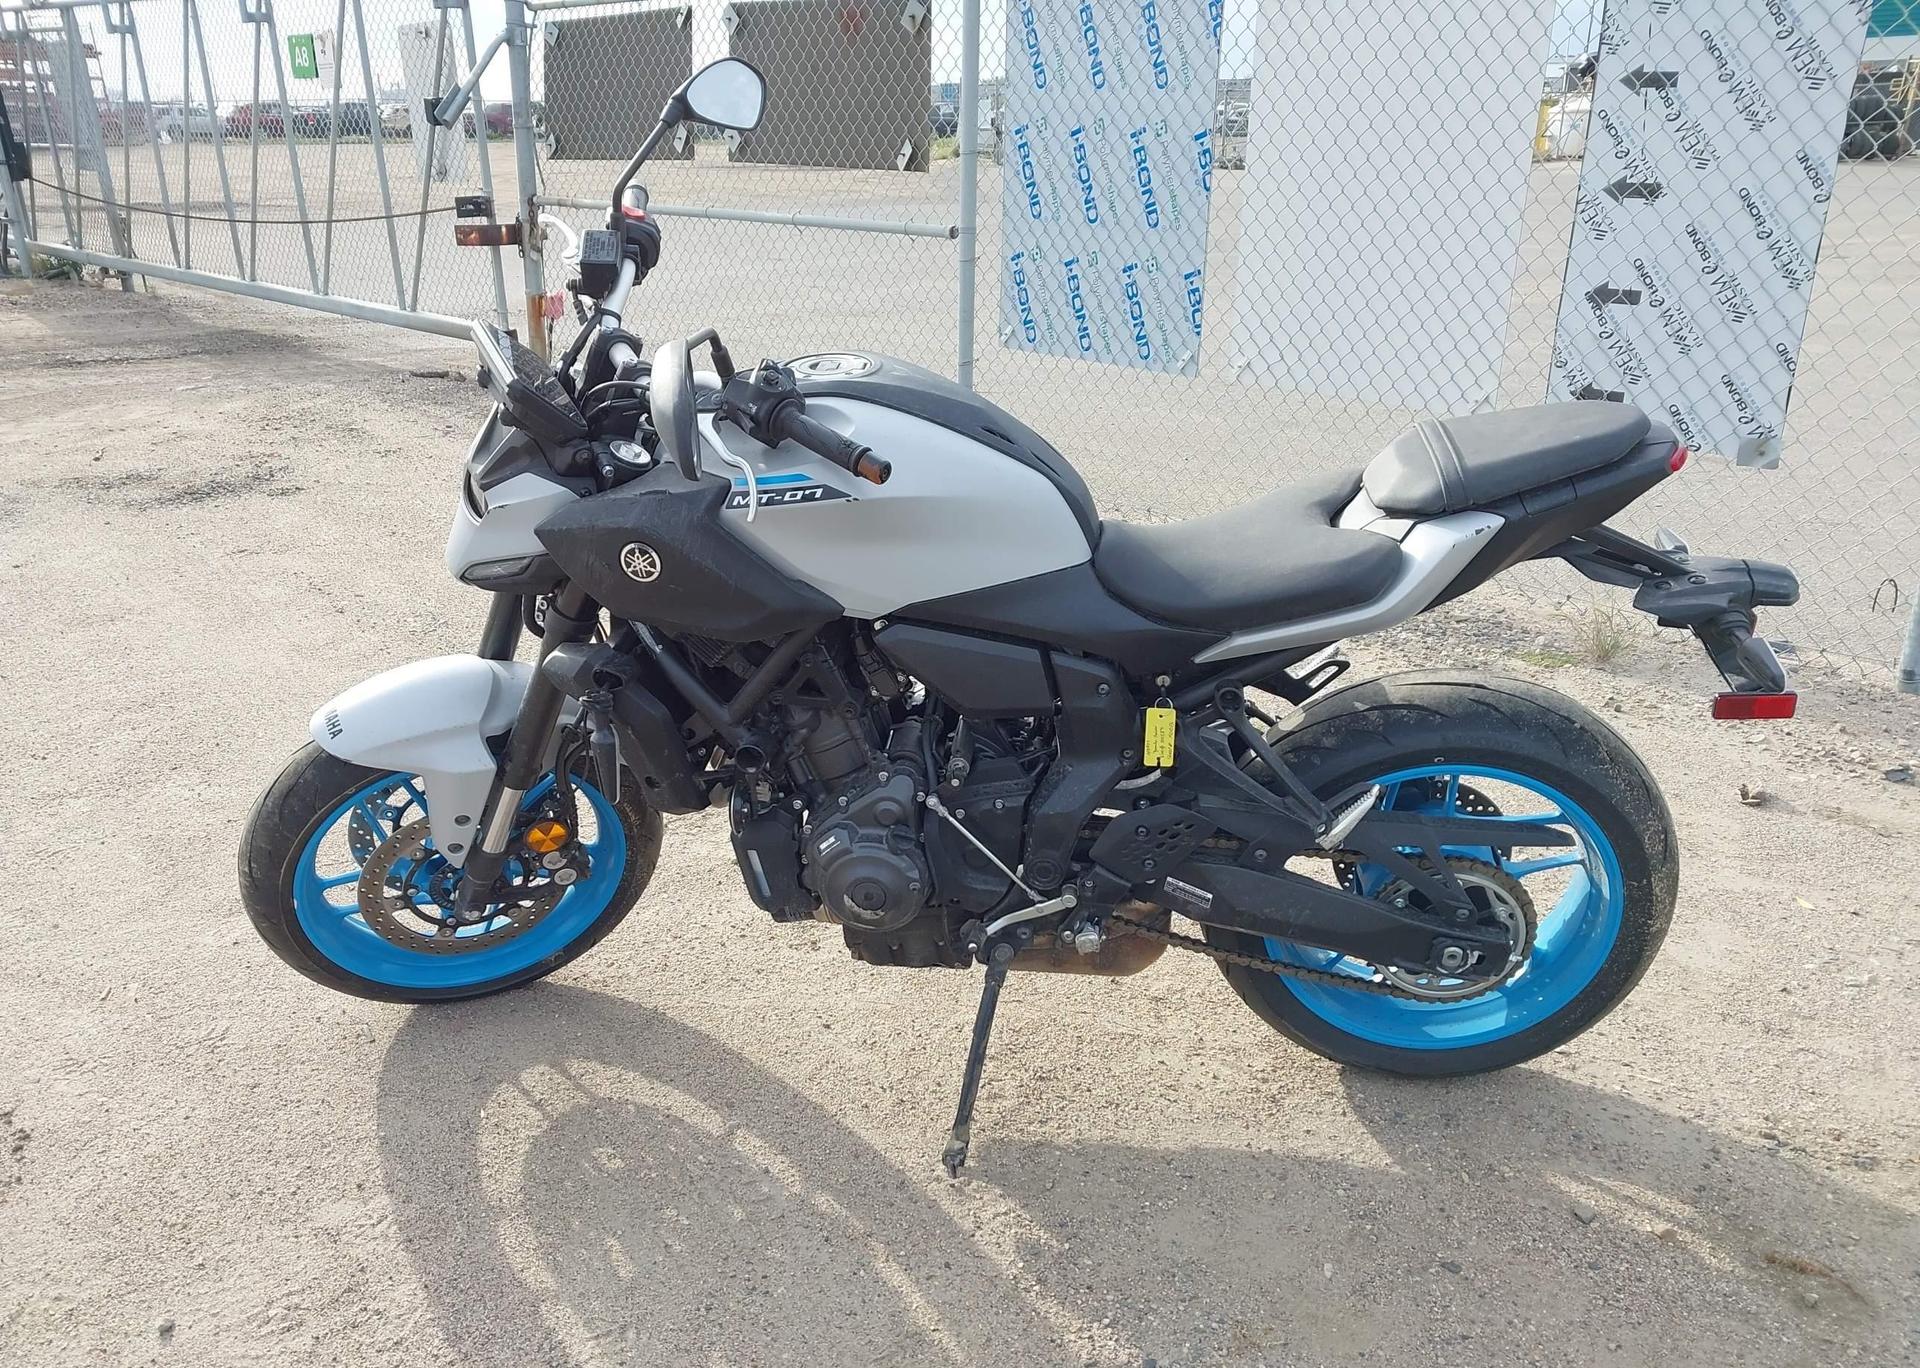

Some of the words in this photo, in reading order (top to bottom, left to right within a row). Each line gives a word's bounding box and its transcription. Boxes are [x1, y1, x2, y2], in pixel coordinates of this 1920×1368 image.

[295, 46, 310, 67] A8
[1744, 75, 1777, 122] PLASTIC
[732, 487, 824, 507] MT-07
